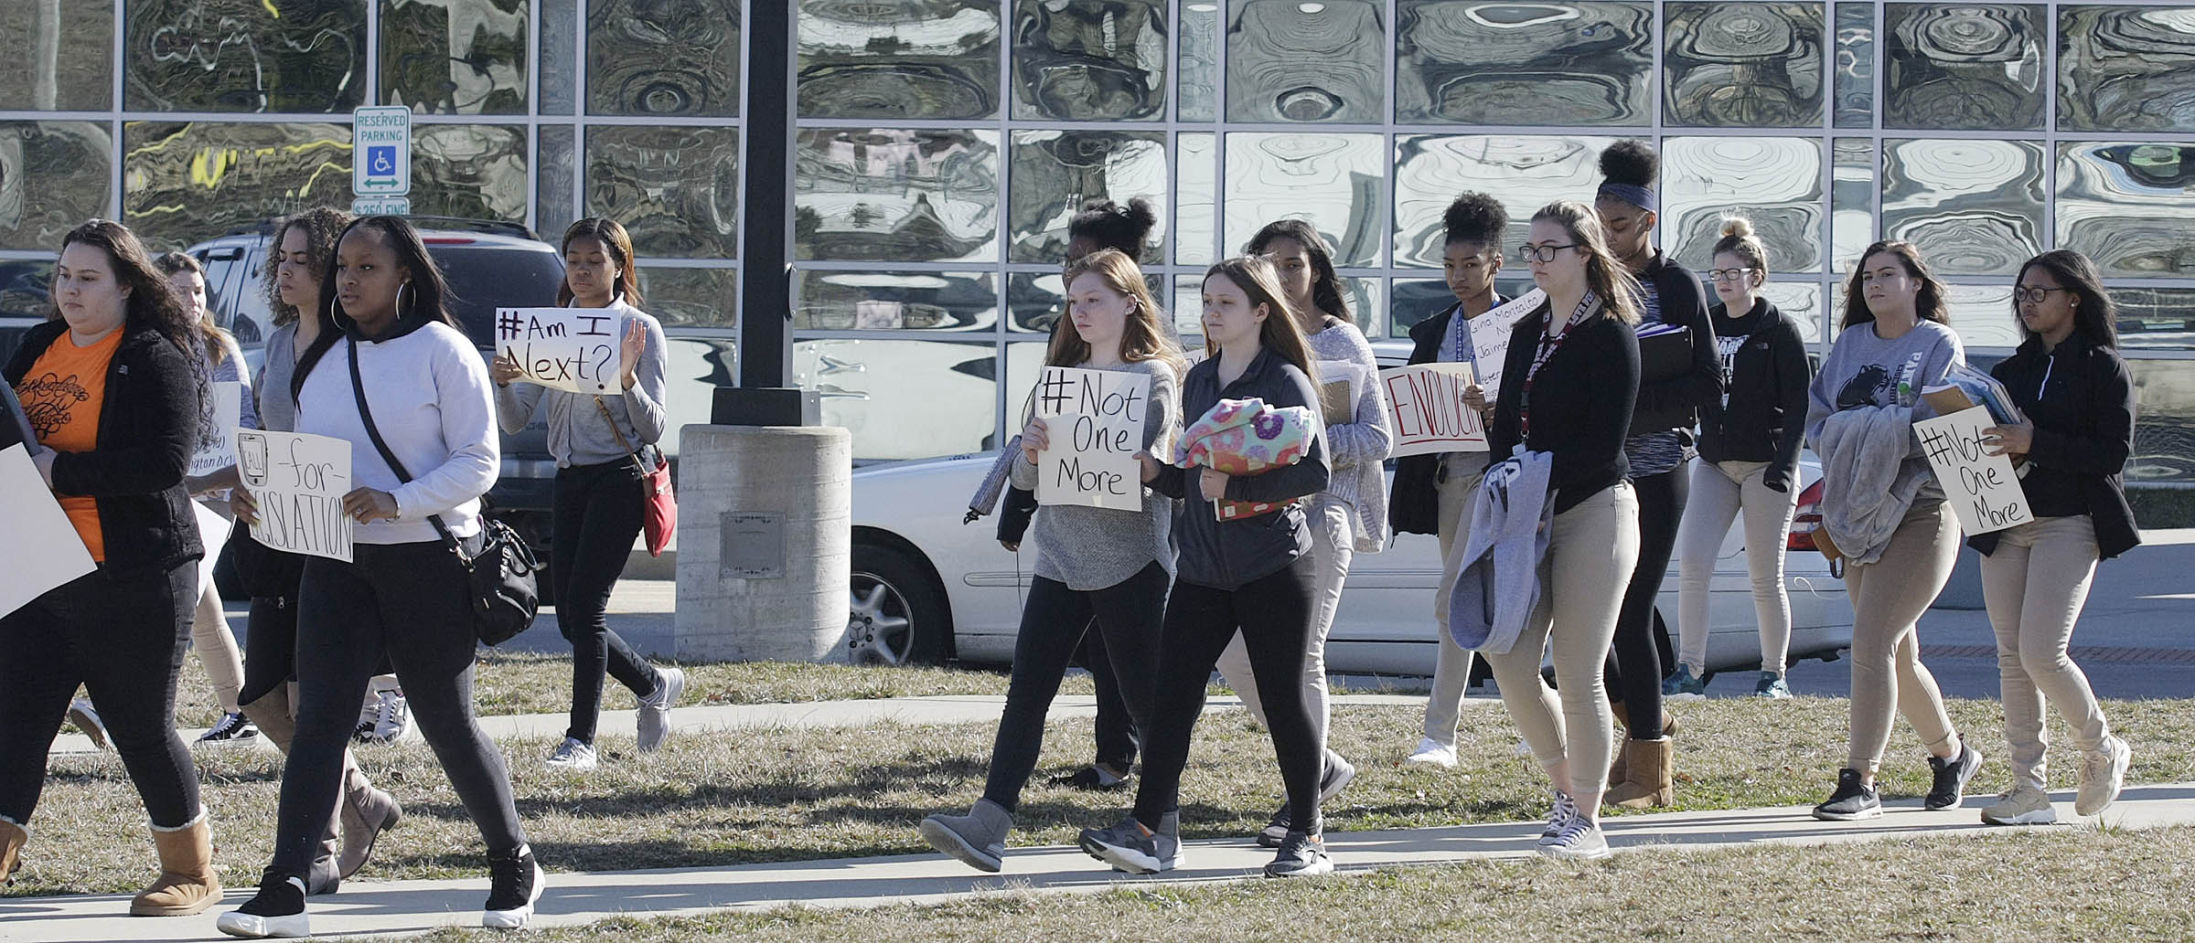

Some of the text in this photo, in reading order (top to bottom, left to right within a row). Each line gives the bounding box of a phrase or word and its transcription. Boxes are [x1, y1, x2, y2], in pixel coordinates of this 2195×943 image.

[358, 115, 406, 127] RESERVED
[361, 130, 403, 141] PARKING
[386, 204, 406, 215] FINE
[498, 310, 611, 341] #Am I
[1470, 296, 1538, 334] Gina Montalto
[506, 342, 613, 391] Next?
[1480, 340, 1508, 359] Jaime
[1041, 369, 1142, 422] #Not
[1074, 415, 1133, 453] One
[1921, 423, 1996, 467] #Not
[1057, 456, 1127, 495] More
[1960, 466, 2004, 496] One
[1973, 495, 2025, 529] More
